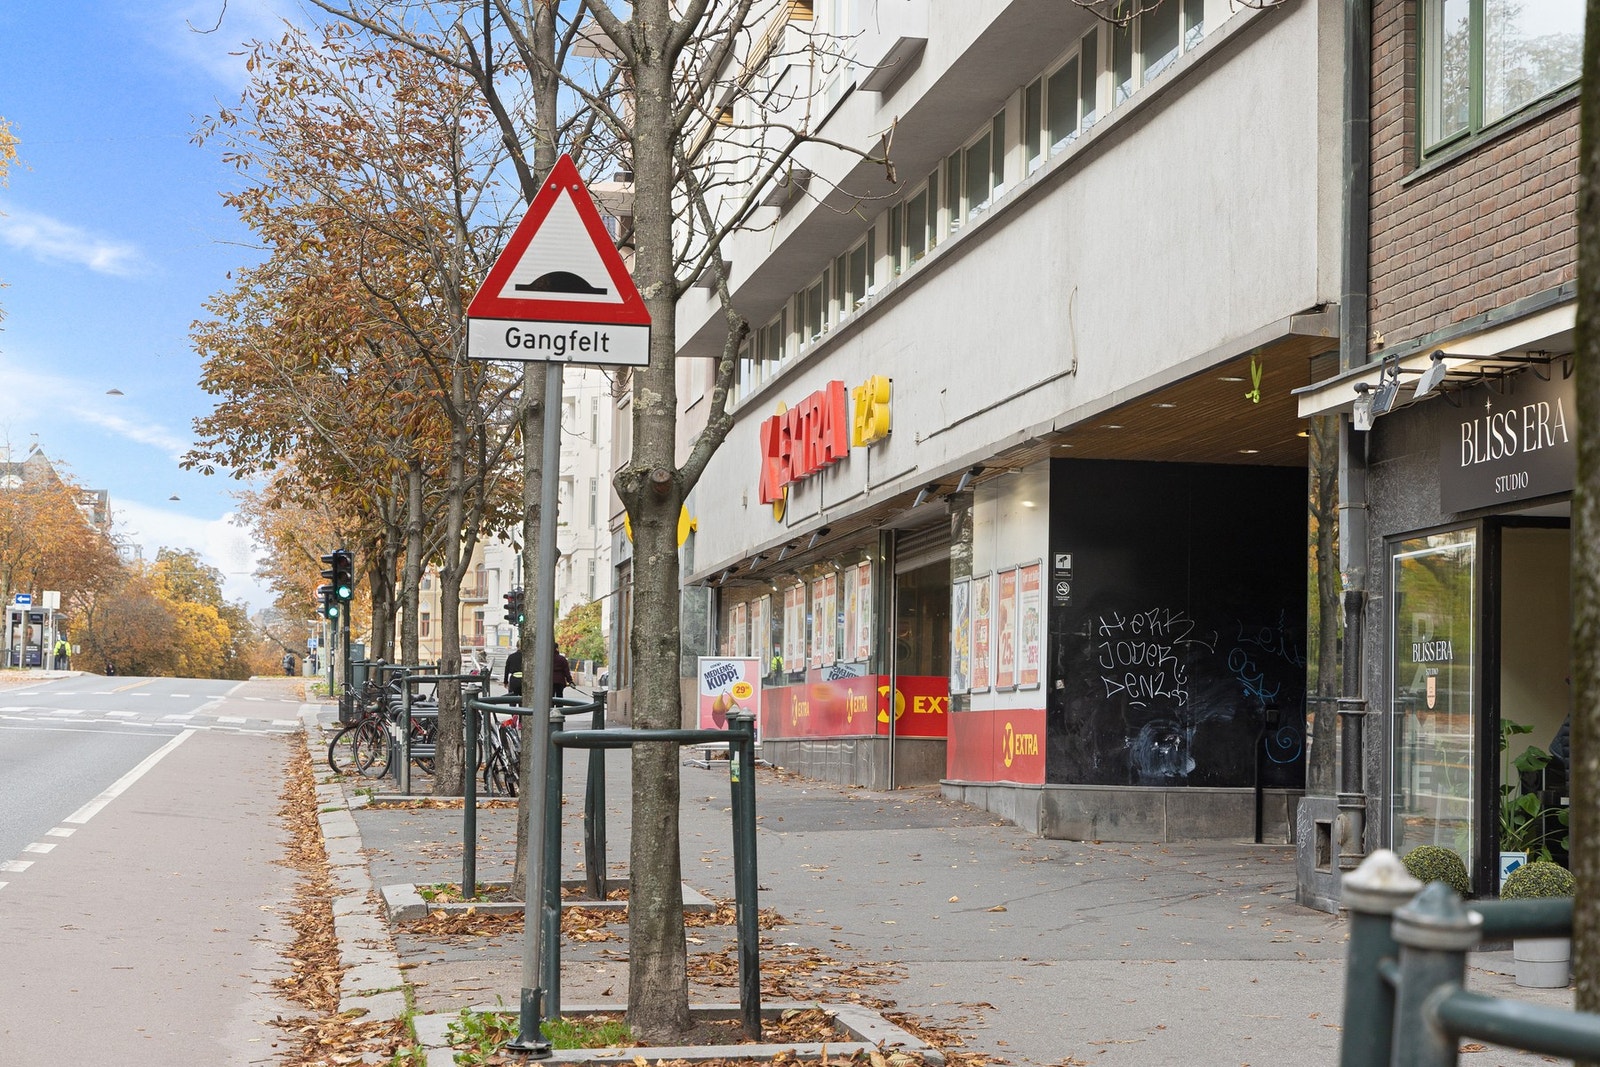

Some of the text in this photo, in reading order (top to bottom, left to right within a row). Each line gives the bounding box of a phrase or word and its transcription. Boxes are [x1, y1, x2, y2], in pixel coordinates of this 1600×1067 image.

[505, 327, 610, 356] Gangfelt
[779, 380, 848, 487] EXTRA
[1461, 397, 1569, 467] BLISS ERA
[1495, 471, 1529, 494] STUDIO
[1412, 640, 1453, 662] BLISS ERA
[704, 663, 735, 679] MEDLEMS-
[706, 669, 740, 690] KUPP!
[798, 701, 809, 717] EXTRA
[852, 695, 868, 712] EXTRA
[1015, 734, 1039, 755] EXTRA
